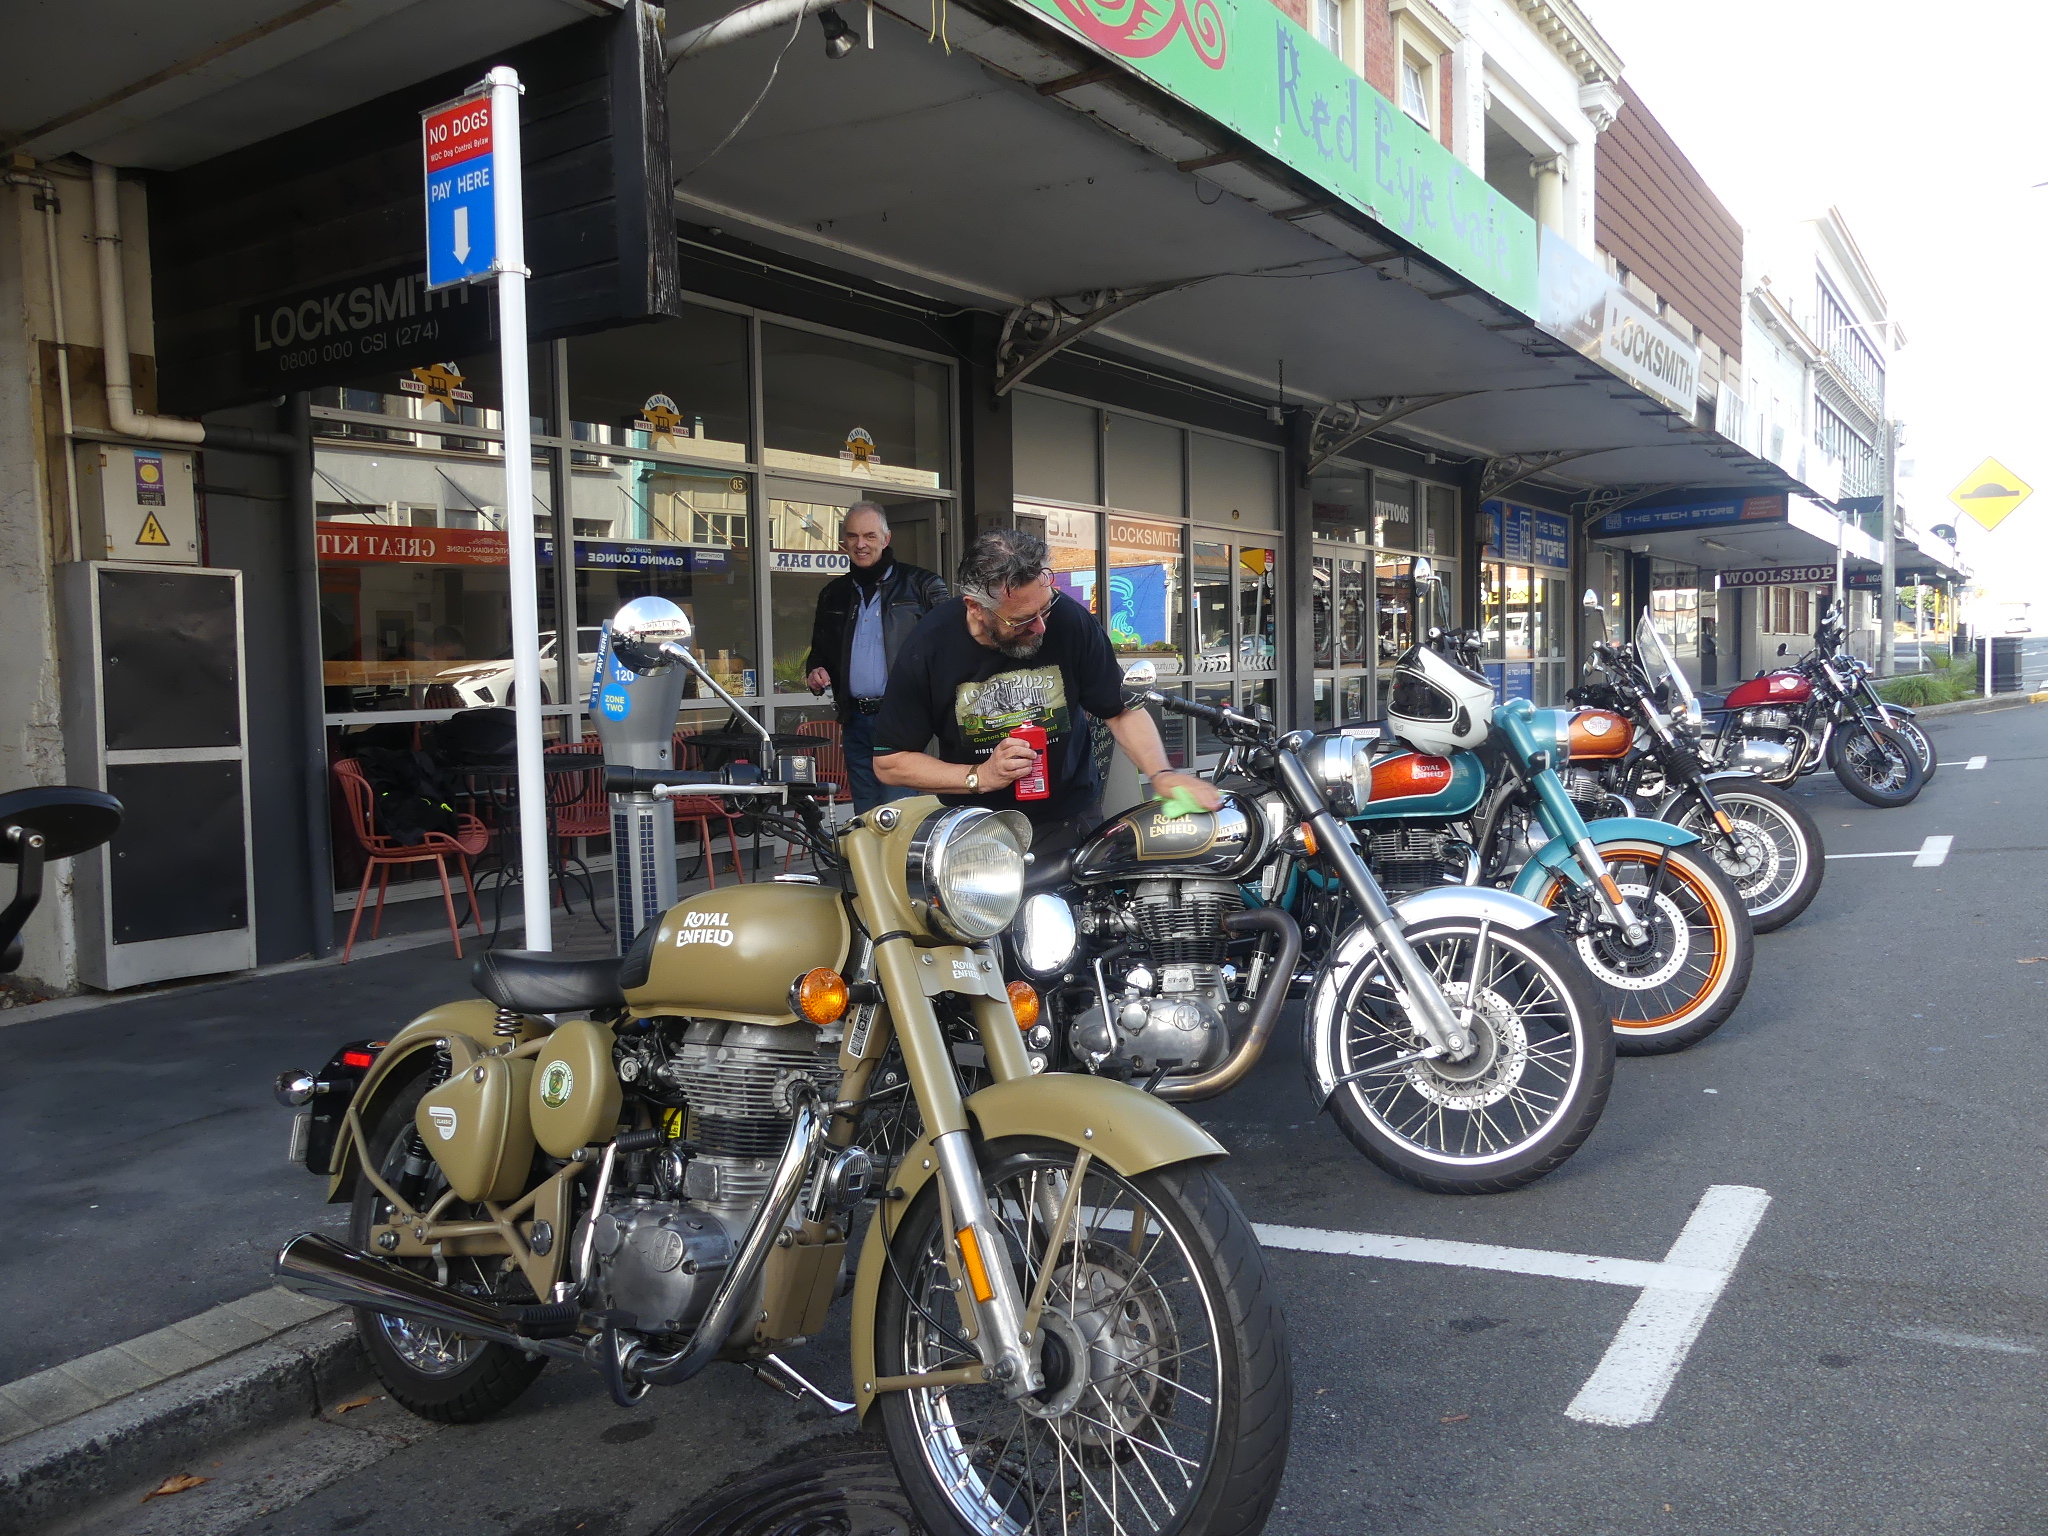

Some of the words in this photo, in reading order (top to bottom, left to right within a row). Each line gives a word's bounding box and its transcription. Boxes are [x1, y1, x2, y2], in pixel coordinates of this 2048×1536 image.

[429, 123, 447, 145] NO
[453, 109, 489, 138] DOGS
[1275, 19, 1359, 174] Red
[1374, 97, 1439, 236] Eye
[444, 148, 454, 158] Dog
[454, 140, 473, 155] Control
[473, 136, 489, 149] Bylaw
[431, 179, 452, 203] PAY
[457, 167, 490, 195] HERE
[279, 348, 317, 371] 0800
[323, 340, 353, 363] 000
[360, 332, 388, 354] CSI
[395, 319, 440, 349] (274)
[1609, 306, 1694, 398] LOCKSMITH
[401, 381, 425, 392] COFFEE
[451, 389, 473, 400] WORKS
[732, 479, 743, 490] 85
[1374, 500, 1409, 524] TATTOOS
[1624, 514, 1650, 524] THE
[1654, 511, 1688, 522] TECH
[1691, 506, 1736, 517] STORE
[1110, 525, 1180, 548] LOCKSMITH
[1535, 520, 1548, 534] THE
[1548, 523, 1566, 538] TECH
[1535, 538, 1566, 559] STORE
[1723, 566, 1835, 586] WOOLSHOP
[599, 632, 608, 656] HERE
[596, 656, 604, 674] PAY
[614, 670, 635, 682] 120
[605, 694, 625, 704] ZONE
[606, 703, 624, 712] TWO
[1150, 824, 1198, 838] ENFIELD
[683, 911, 730, 928] ROYAL
[676, 929, 734, 948] ENFIELD
[952, 960, 976, 970] ROYAL
[952, 970, 980, 980] ENFIELD
